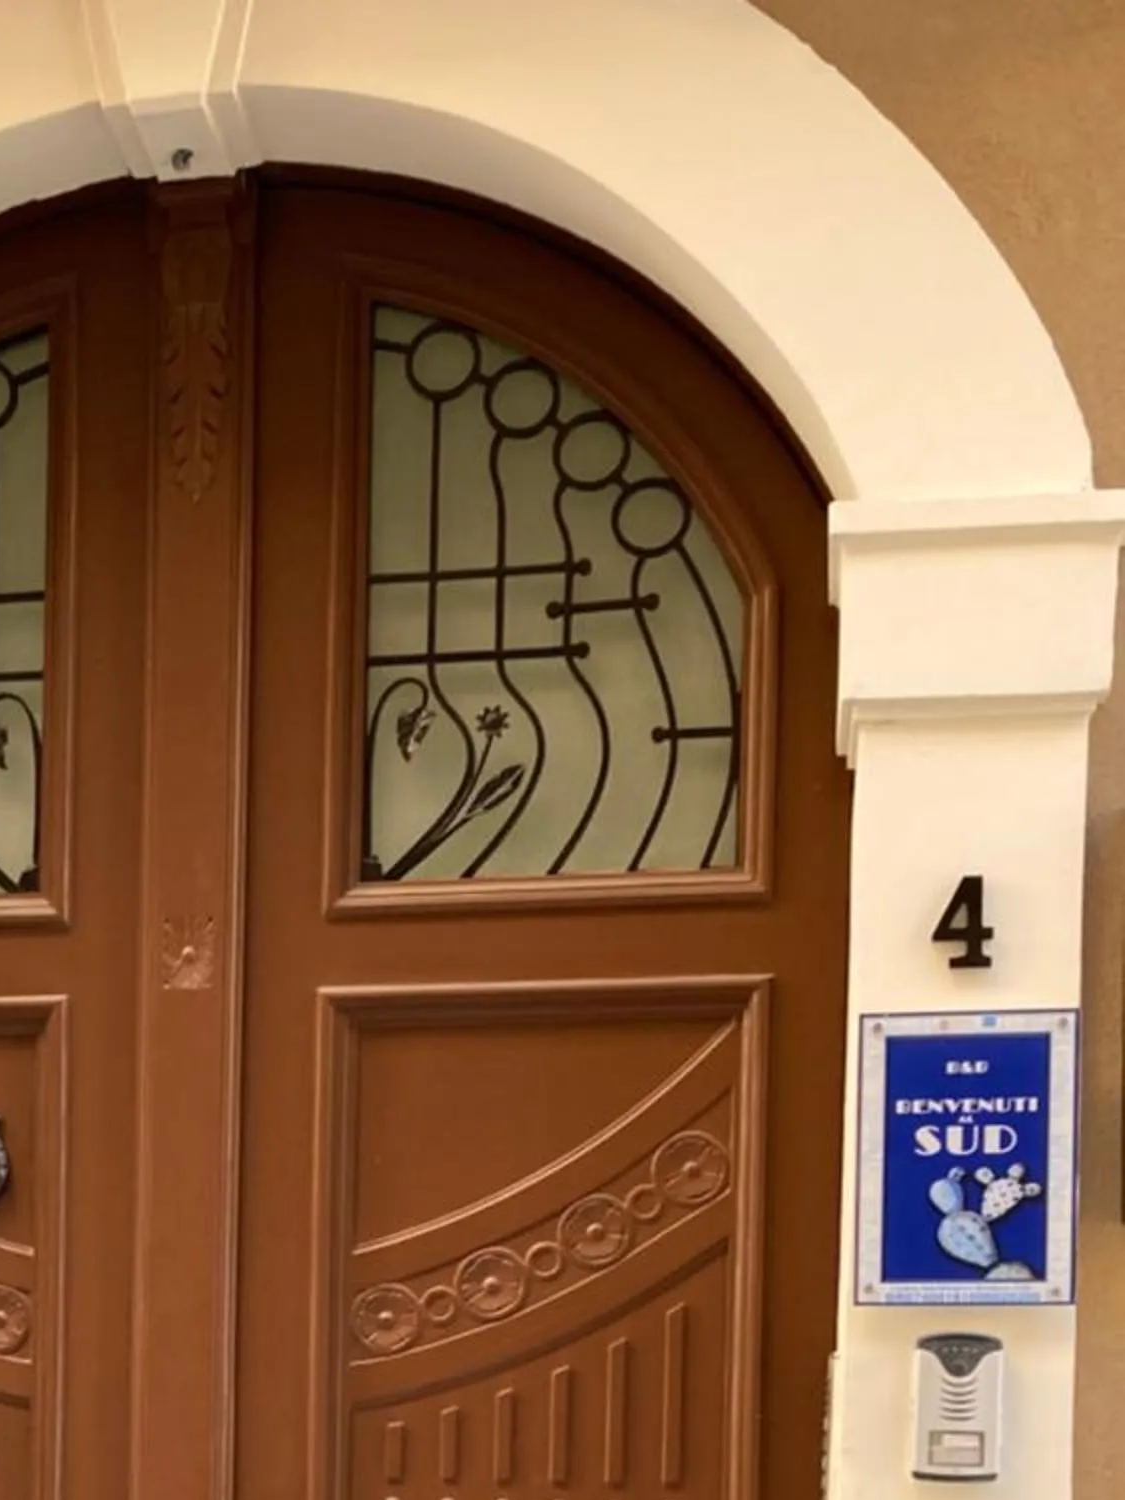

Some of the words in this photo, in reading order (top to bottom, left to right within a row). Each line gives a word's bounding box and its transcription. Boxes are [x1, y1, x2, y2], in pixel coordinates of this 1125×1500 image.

[931, 875, 994, 969] 4
[895, 1097, 1039, 1114] BENVENUTI
[913, 1124, 1018, 1157] SUD
